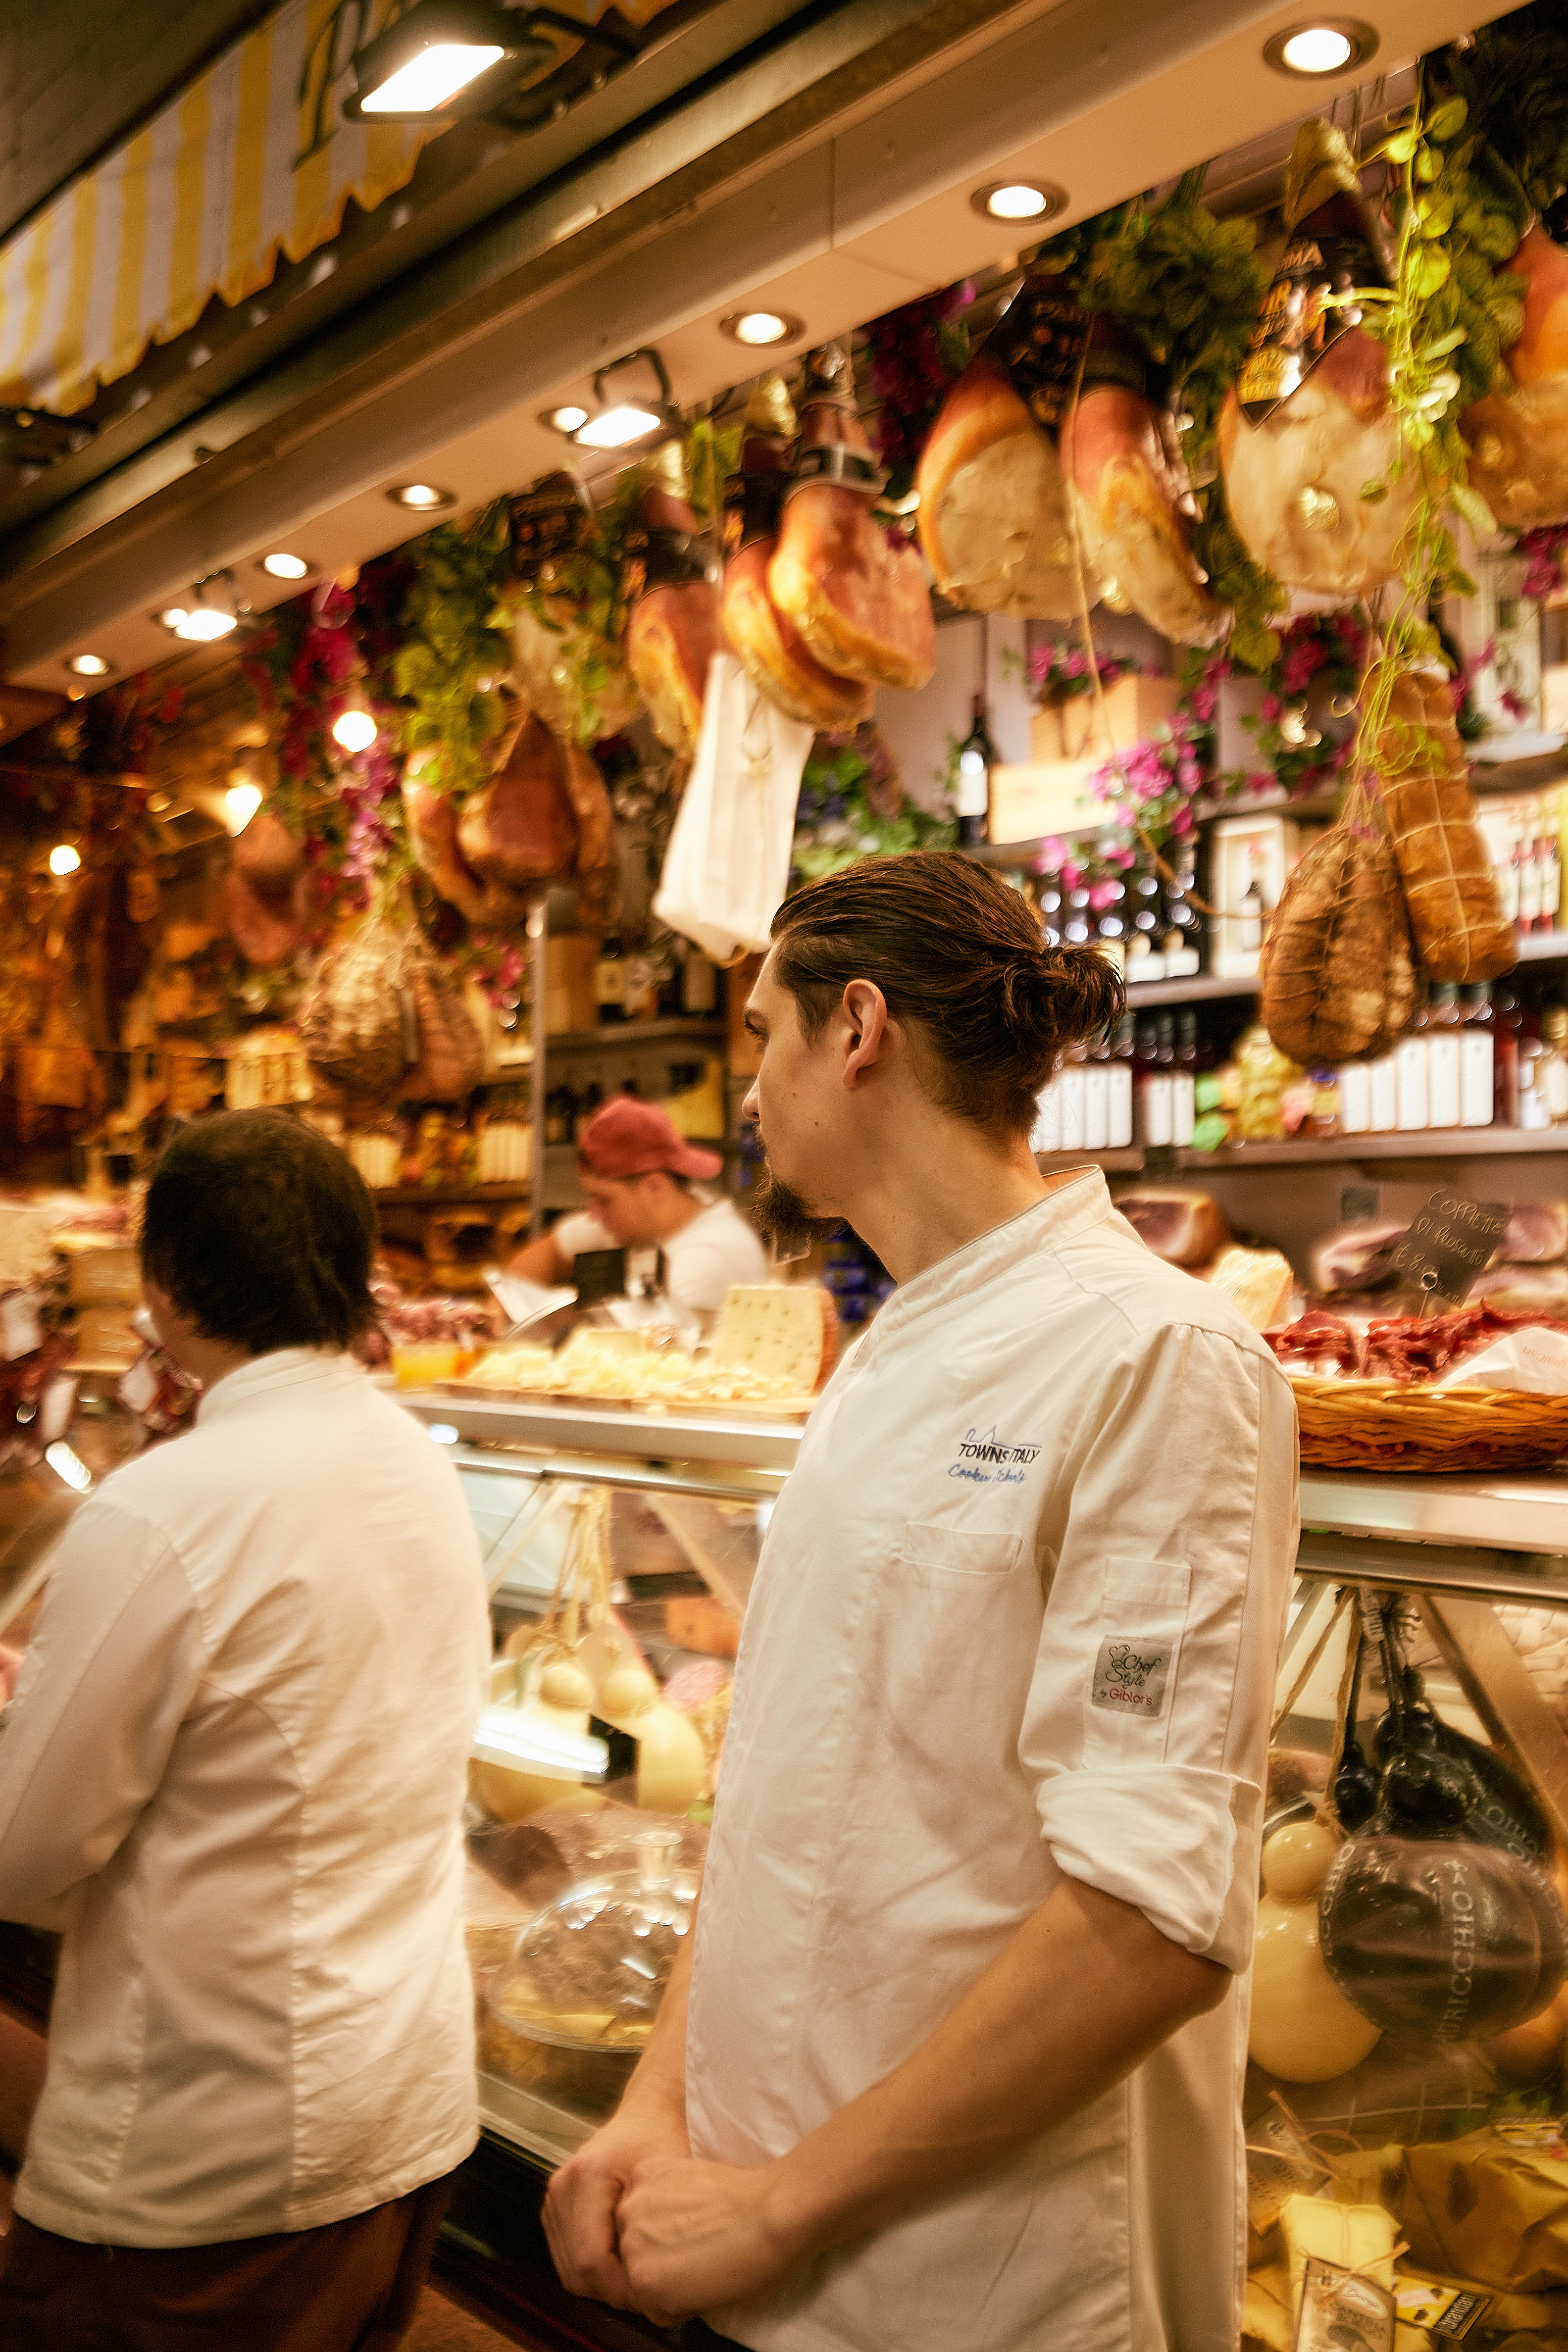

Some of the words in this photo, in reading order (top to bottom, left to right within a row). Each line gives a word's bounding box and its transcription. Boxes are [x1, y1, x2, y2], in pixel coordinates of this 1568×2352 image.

[1123, 1655, 1161, 1676] Chef
[1106, 1667, 1146, 1689] Style
[1109, 1688, 1153, 1706] Giblor's
